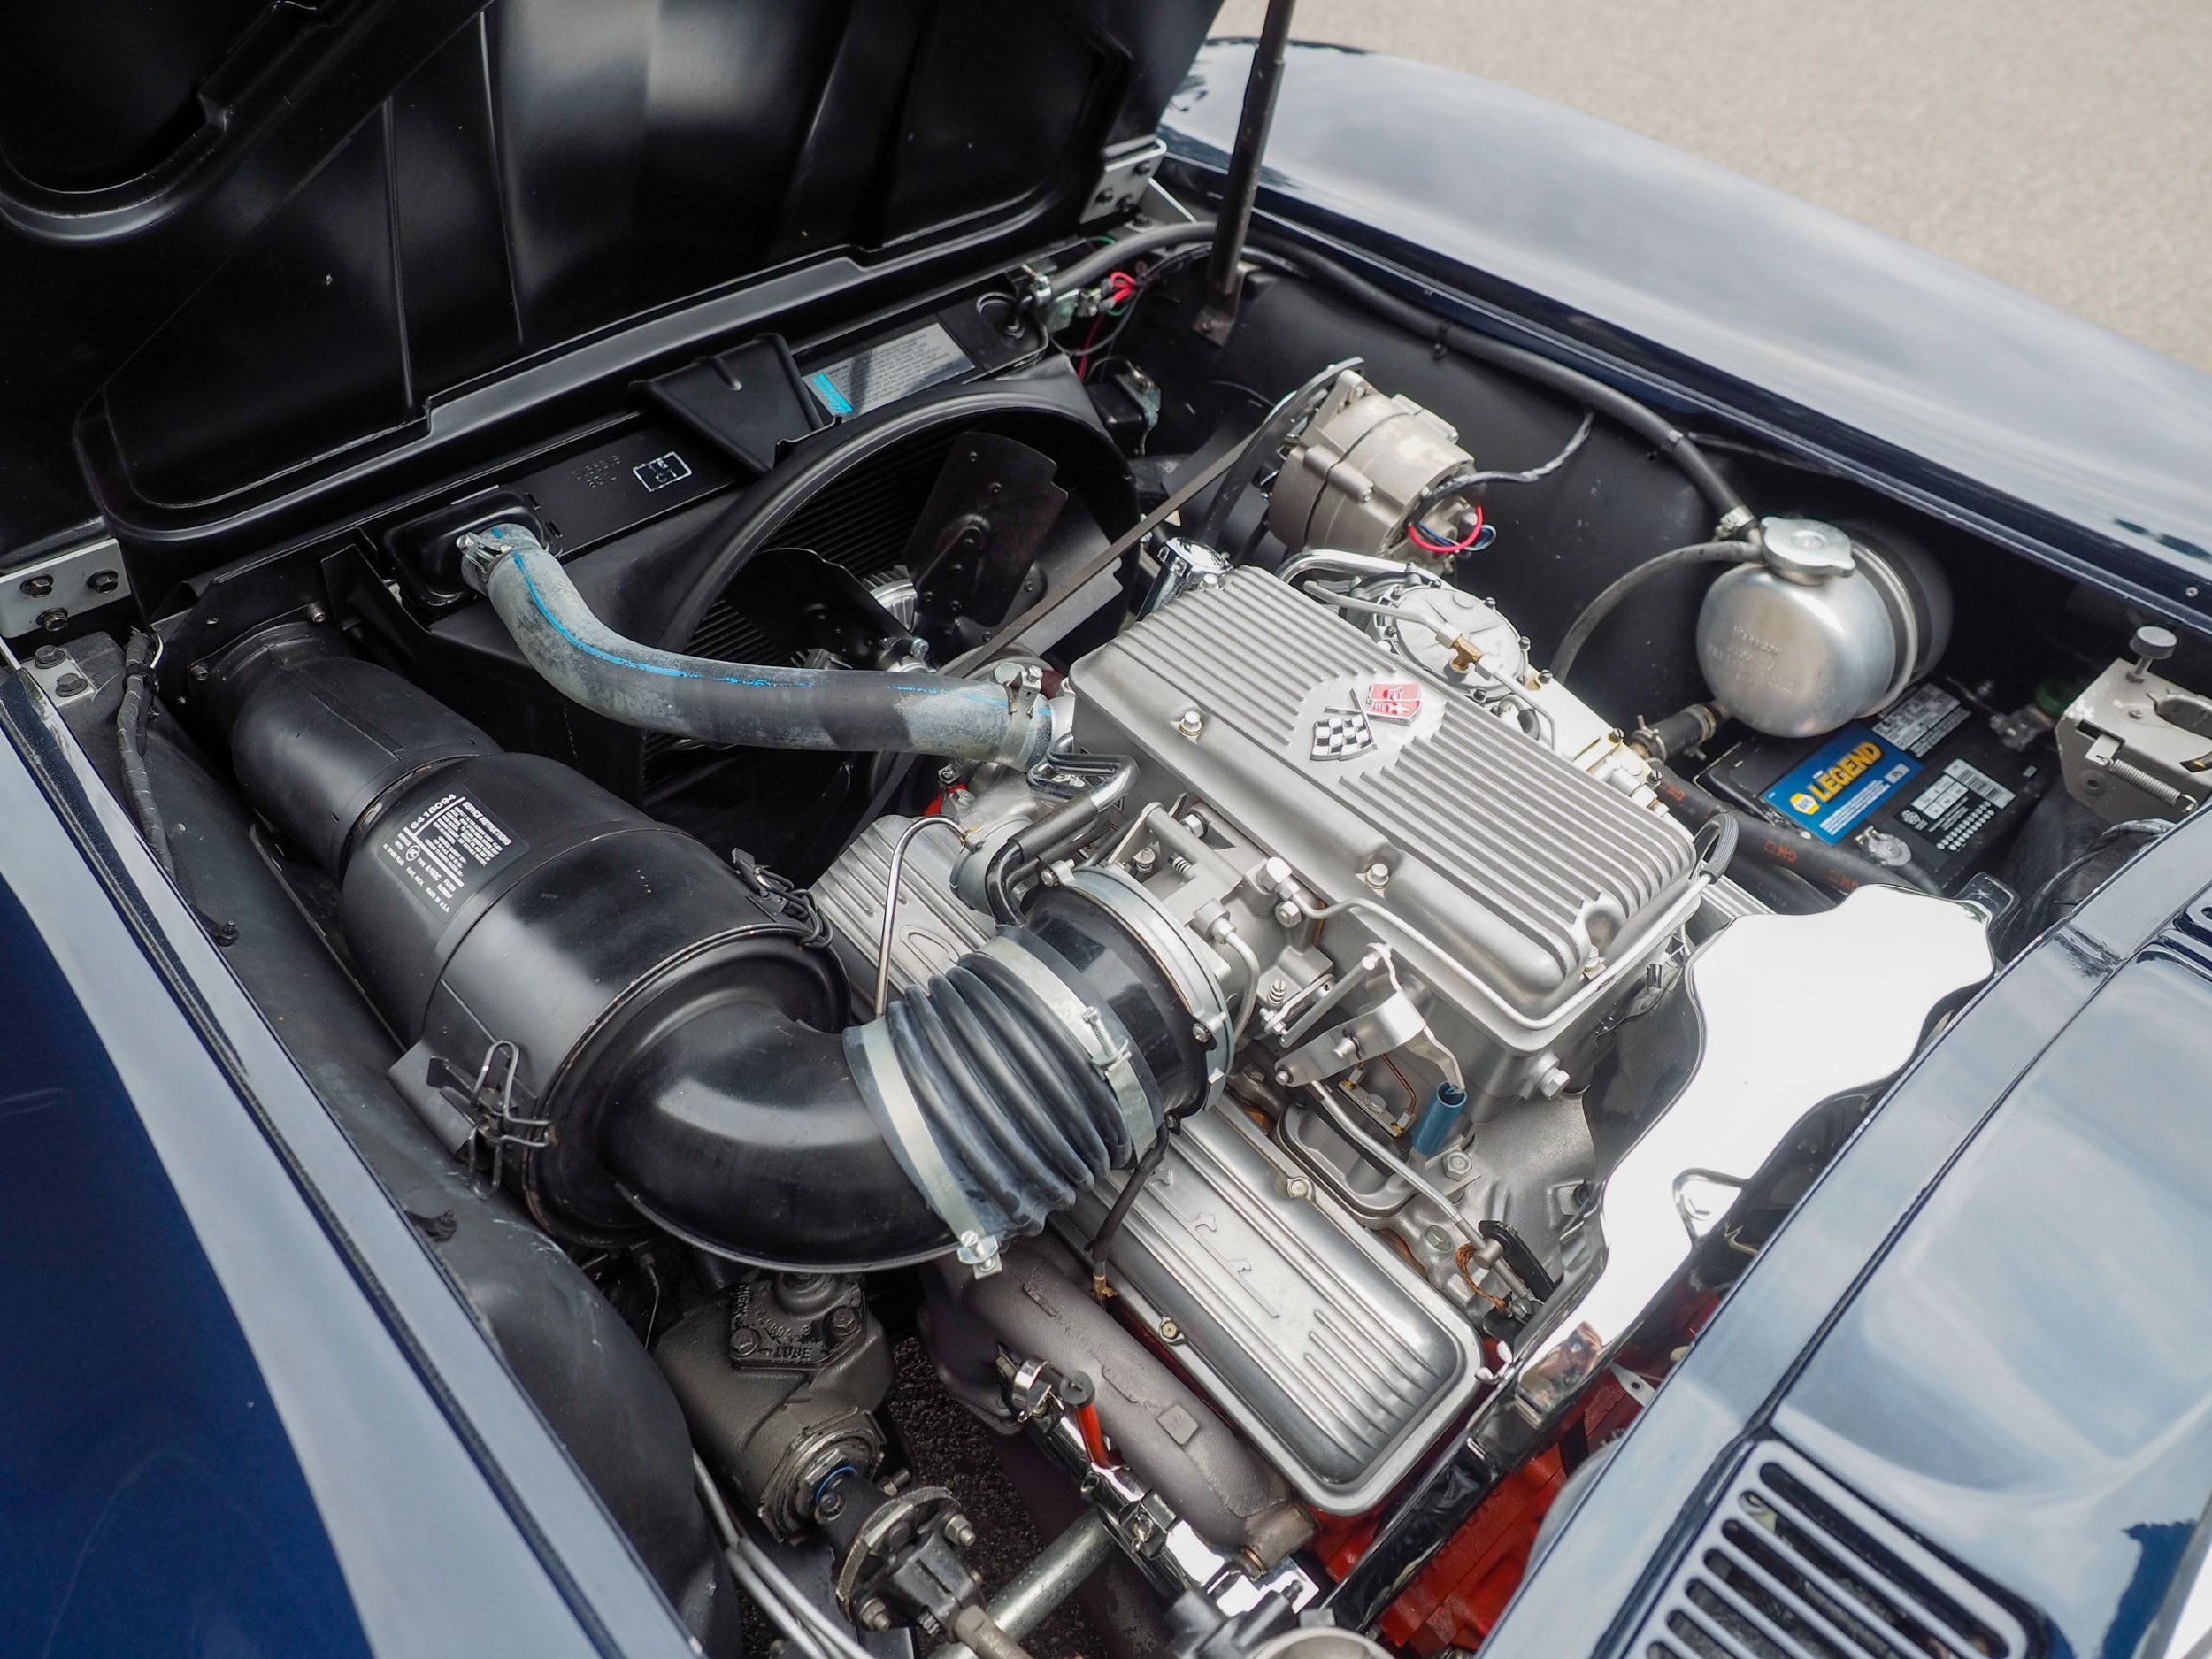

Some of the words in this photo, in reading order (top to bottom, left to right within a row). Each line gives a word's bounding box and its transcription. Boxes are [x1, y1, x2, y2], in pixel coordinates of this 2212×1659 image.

[1807, 741, 1883, 803] LEGEND
[410, 793, 457, 830] 6418094
[462, 801, 483, 819] SERVICE
[478, 814, 512, 846] INSTRUCTIONS
